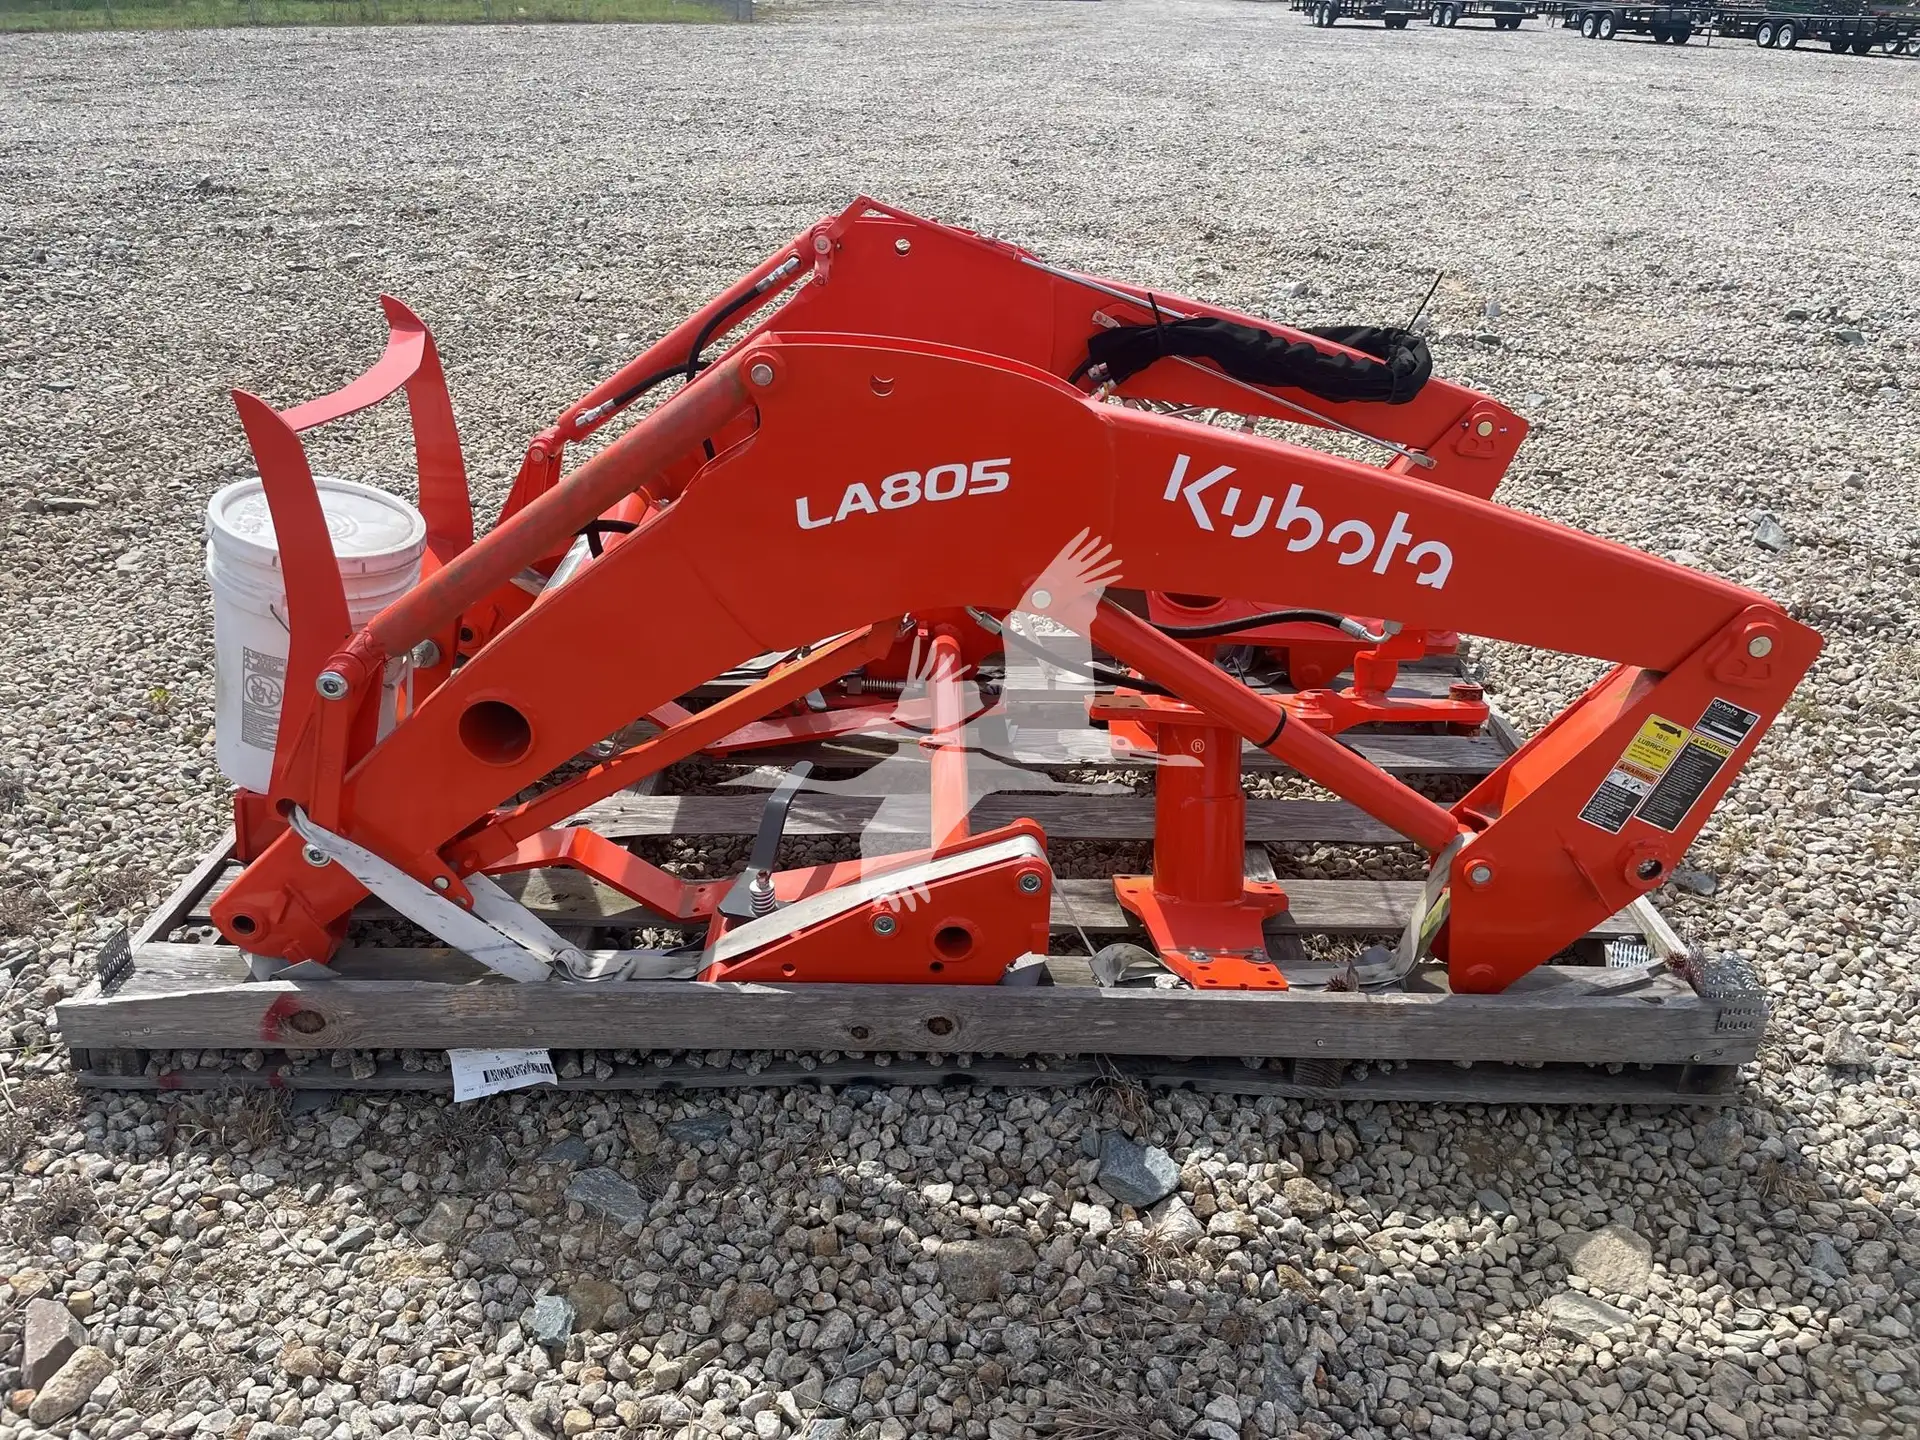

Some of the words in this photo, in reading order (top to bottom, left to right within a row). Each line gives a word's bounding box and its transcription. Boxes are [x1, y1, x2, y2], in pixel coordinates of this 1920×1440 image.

[796, 457, 1012, 530] LA805
[1163, 453, 1454, 590] Kubota
[1637, 737, 1672, 757] LUBRICATE
[1699, 739, 1730, 756] CAUTION
